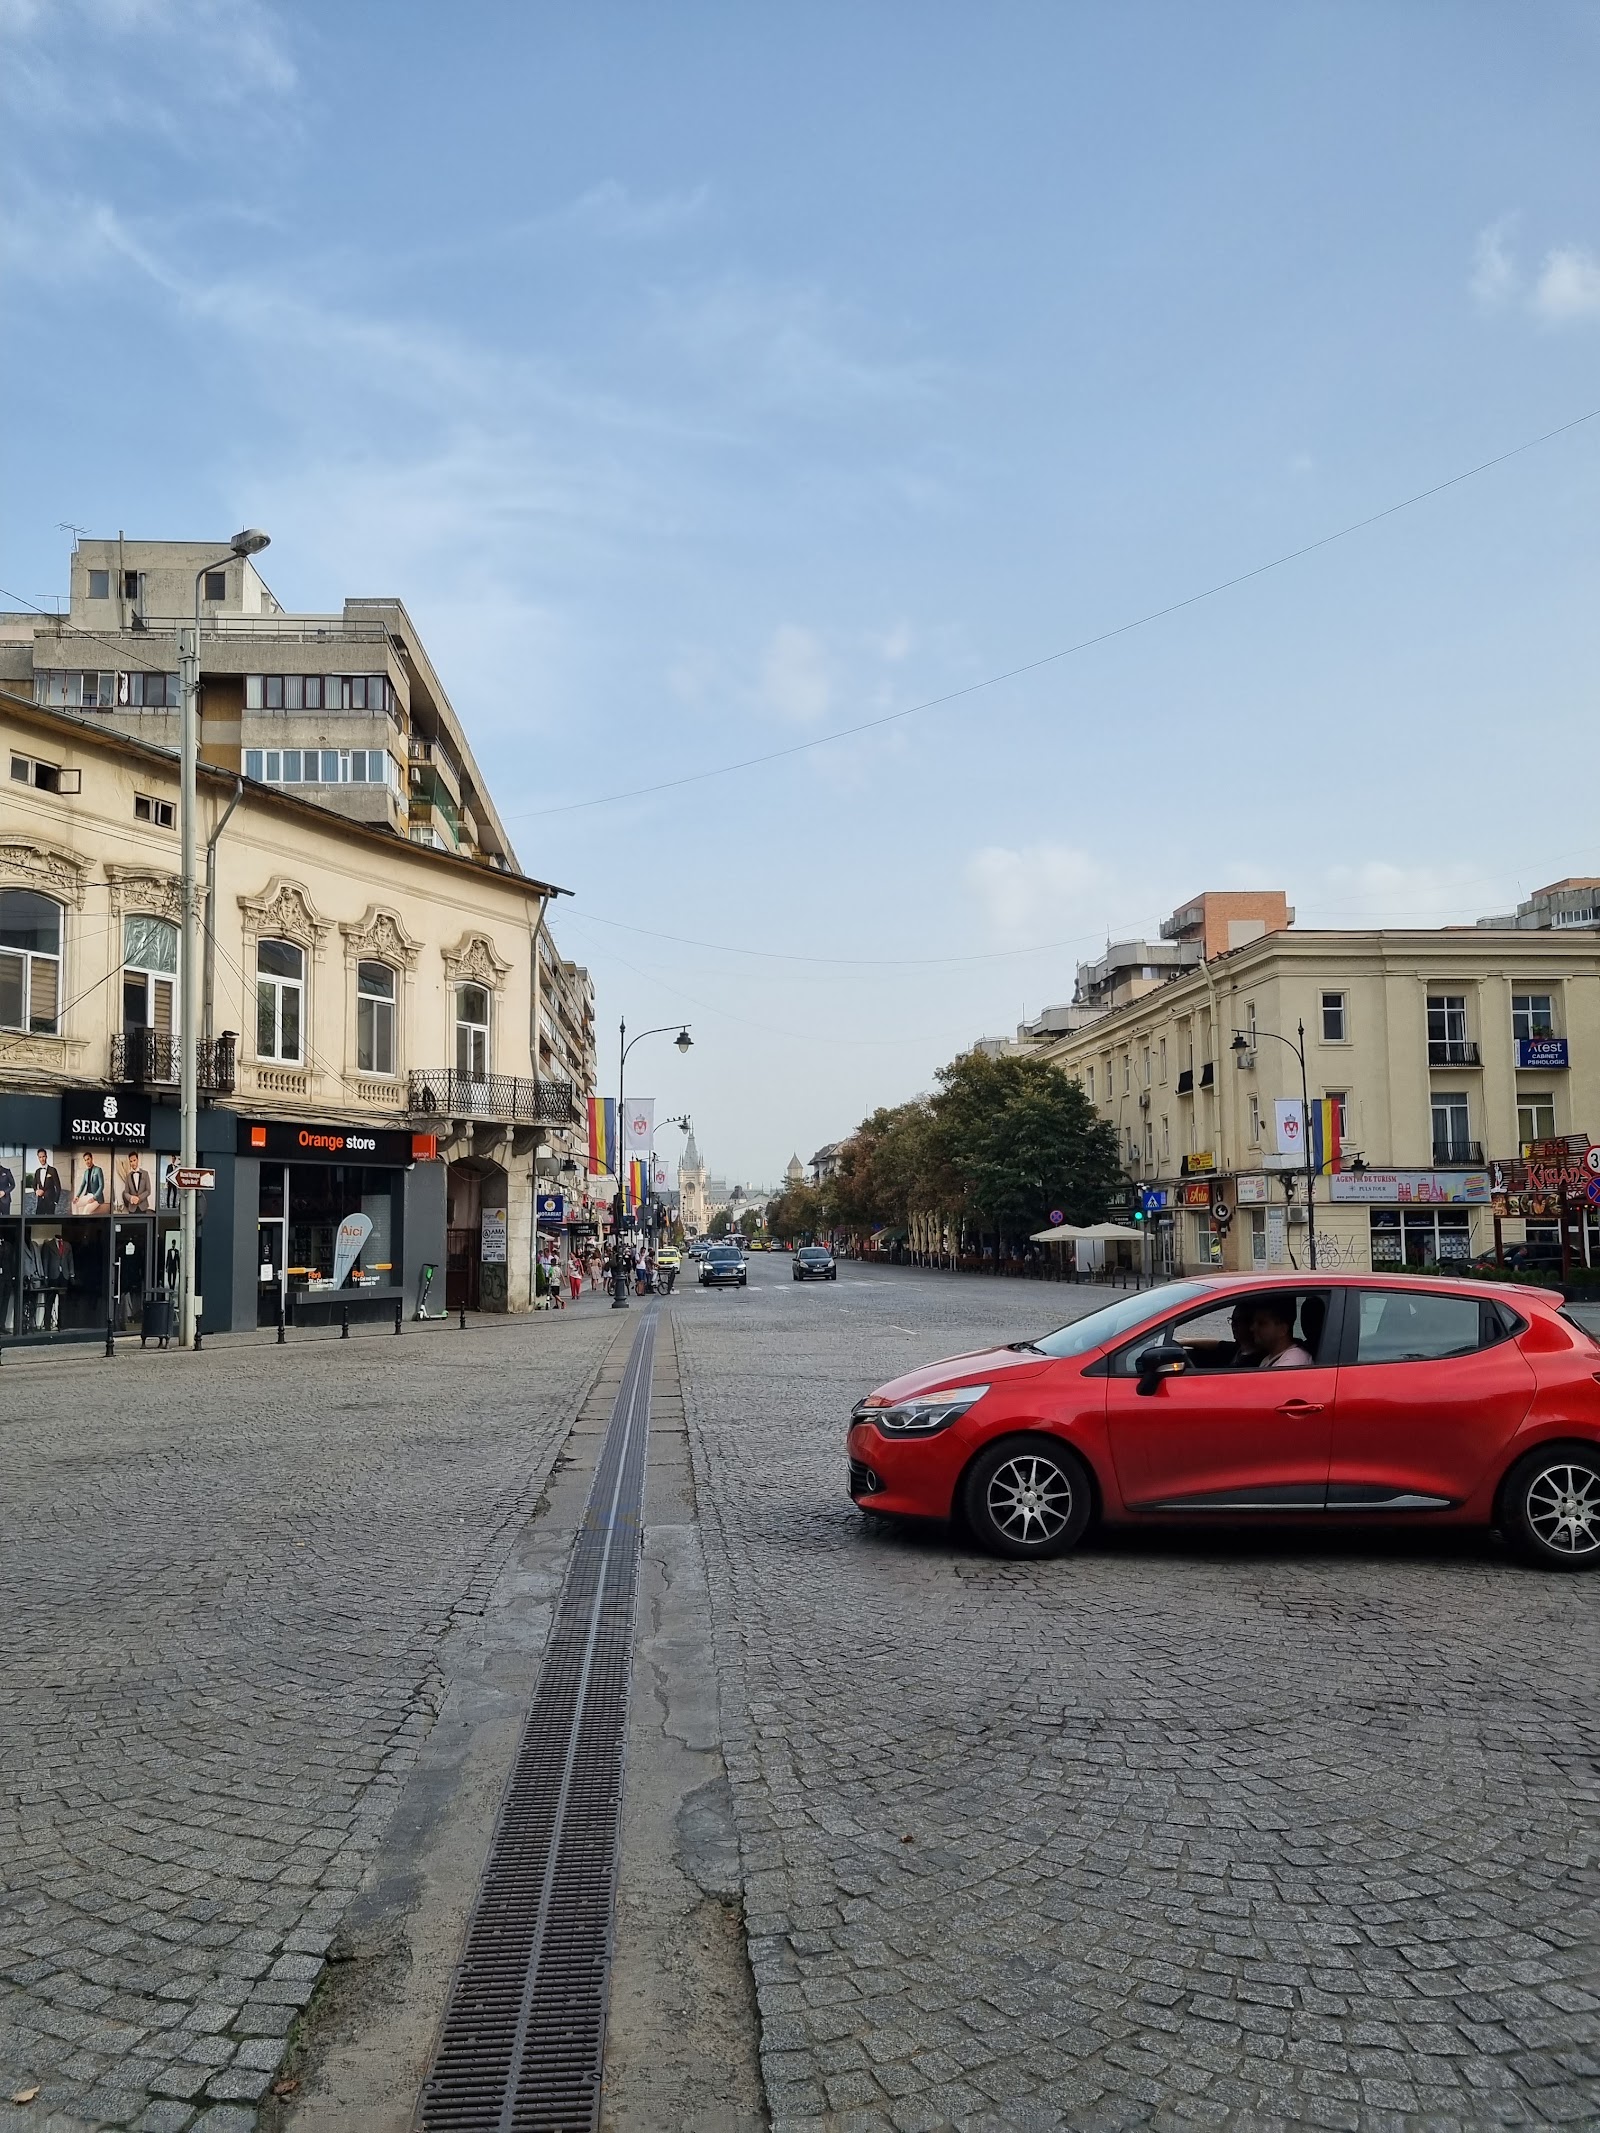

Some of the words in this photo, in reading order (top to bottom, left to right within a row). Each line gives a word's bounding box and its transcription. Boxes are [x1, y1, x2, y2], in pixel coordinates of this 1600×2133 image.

[72, 1119, 146, 1137] SEROUSSI
[299, 1131, 344, 1151] Orange
[346, 1135, 376, 1150] store
[341, 1225, 363, 1236] Aici
